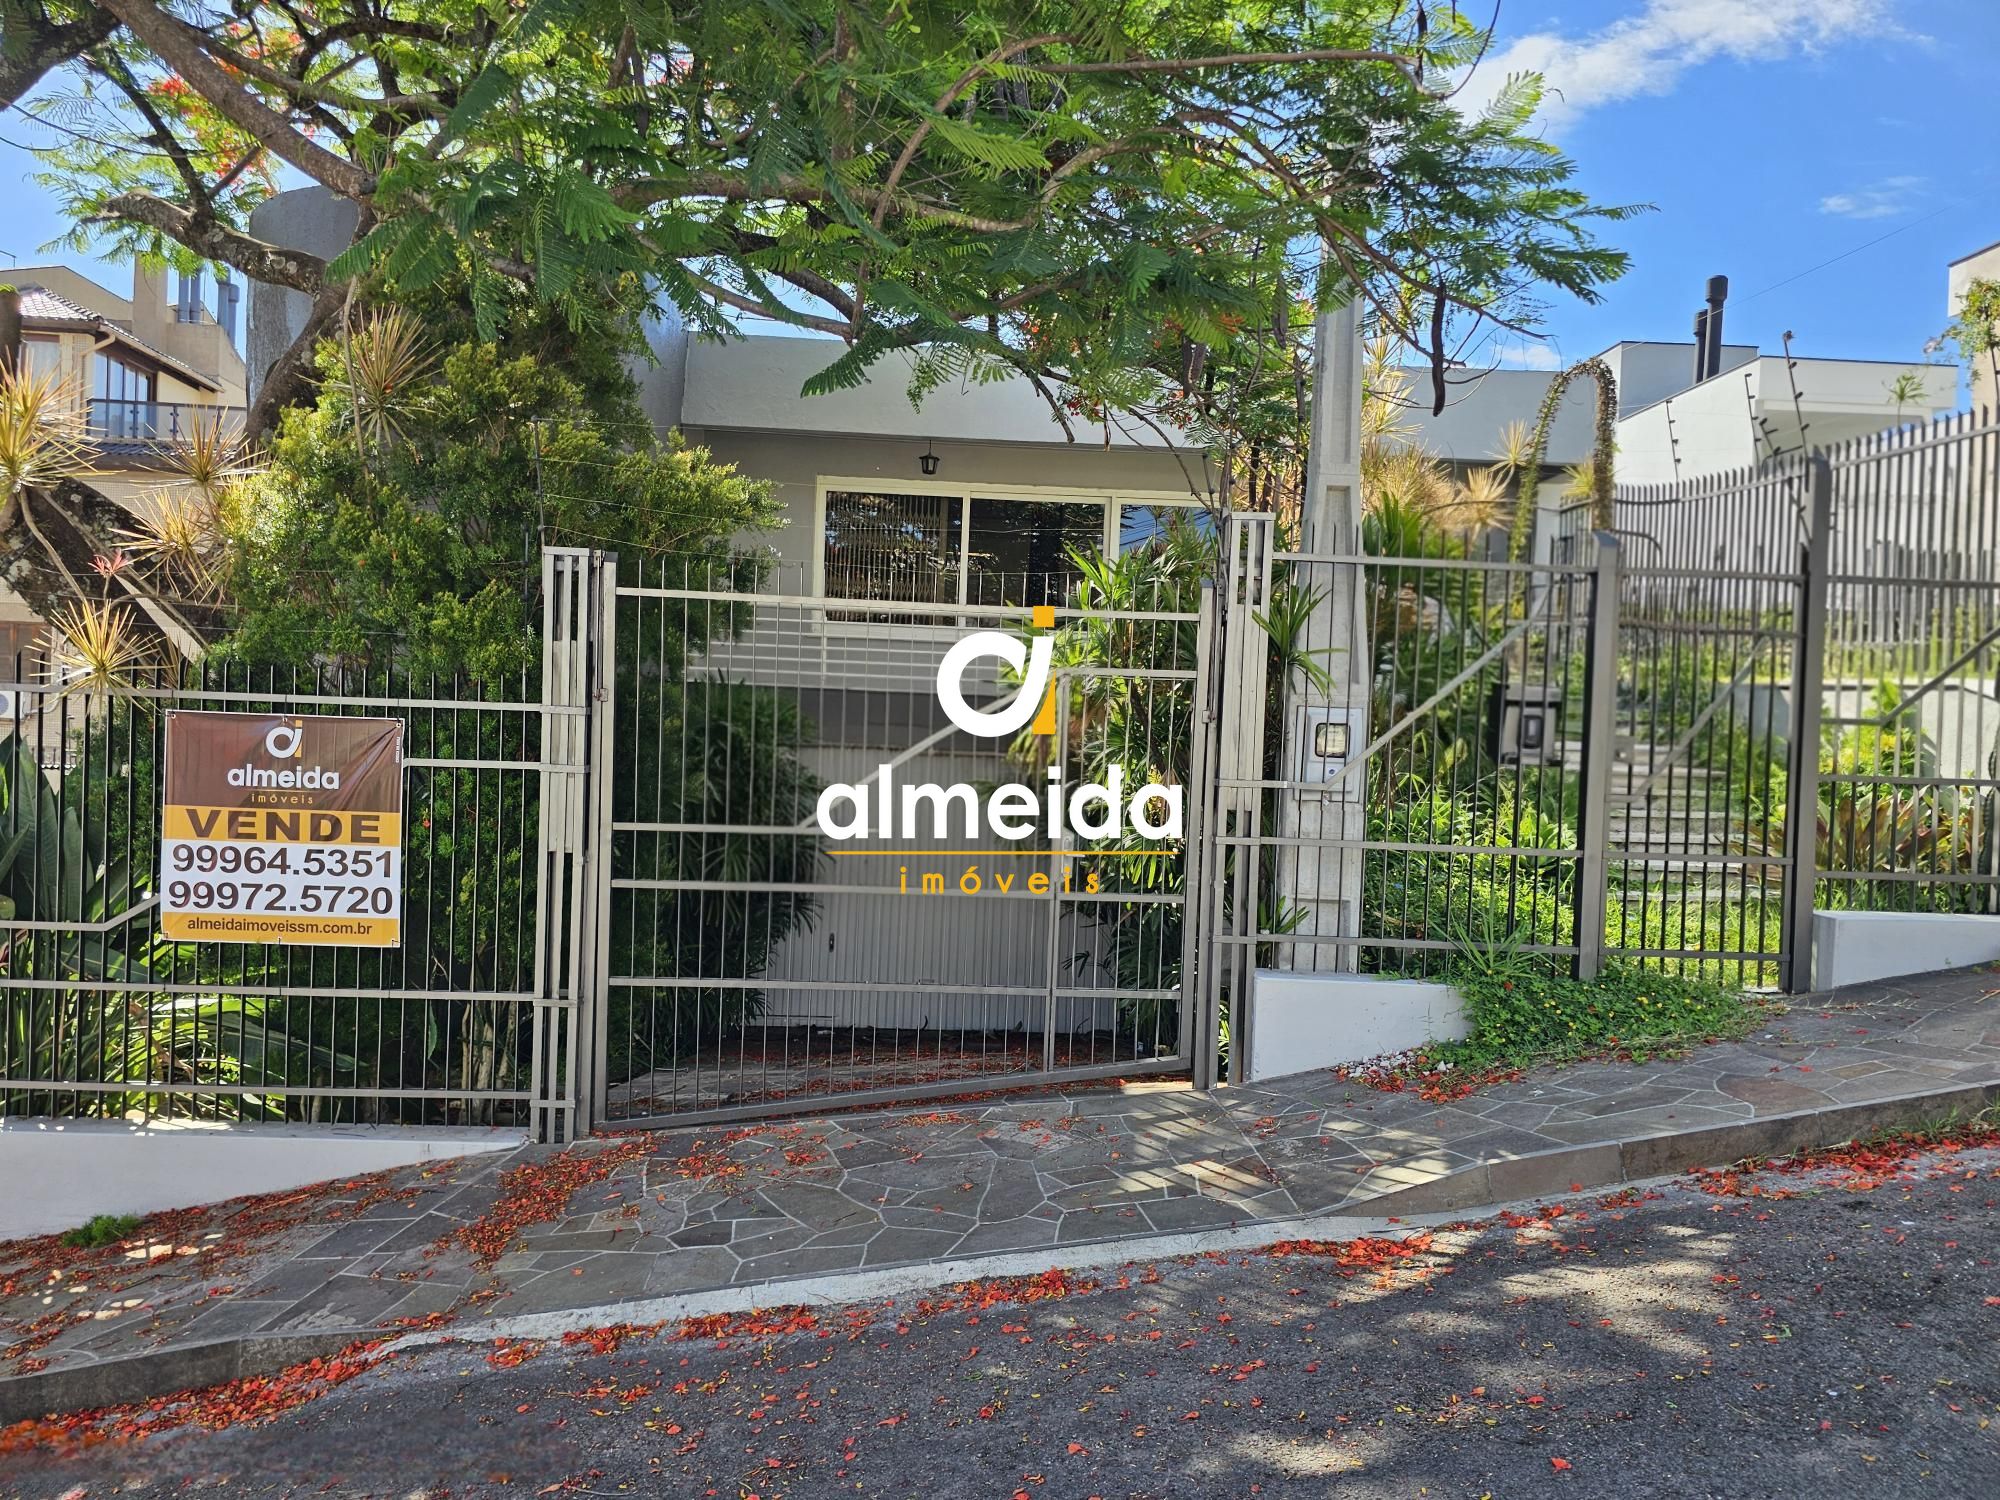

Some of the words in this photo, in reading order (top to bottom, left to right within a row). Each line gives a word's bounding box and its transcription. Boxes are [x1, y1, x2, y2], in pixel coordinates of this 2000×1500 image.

[227, 763, 340, 790] almeida
[251, 793, 314, 804] imóveis
[185, 808, 381, 844] VENDE
[172, 843, 392, 878] 99964.5351
[168, 880, 393, 914] 99972.5720
[187, 916, 373, 935] almeidaimoveissm.com.br
